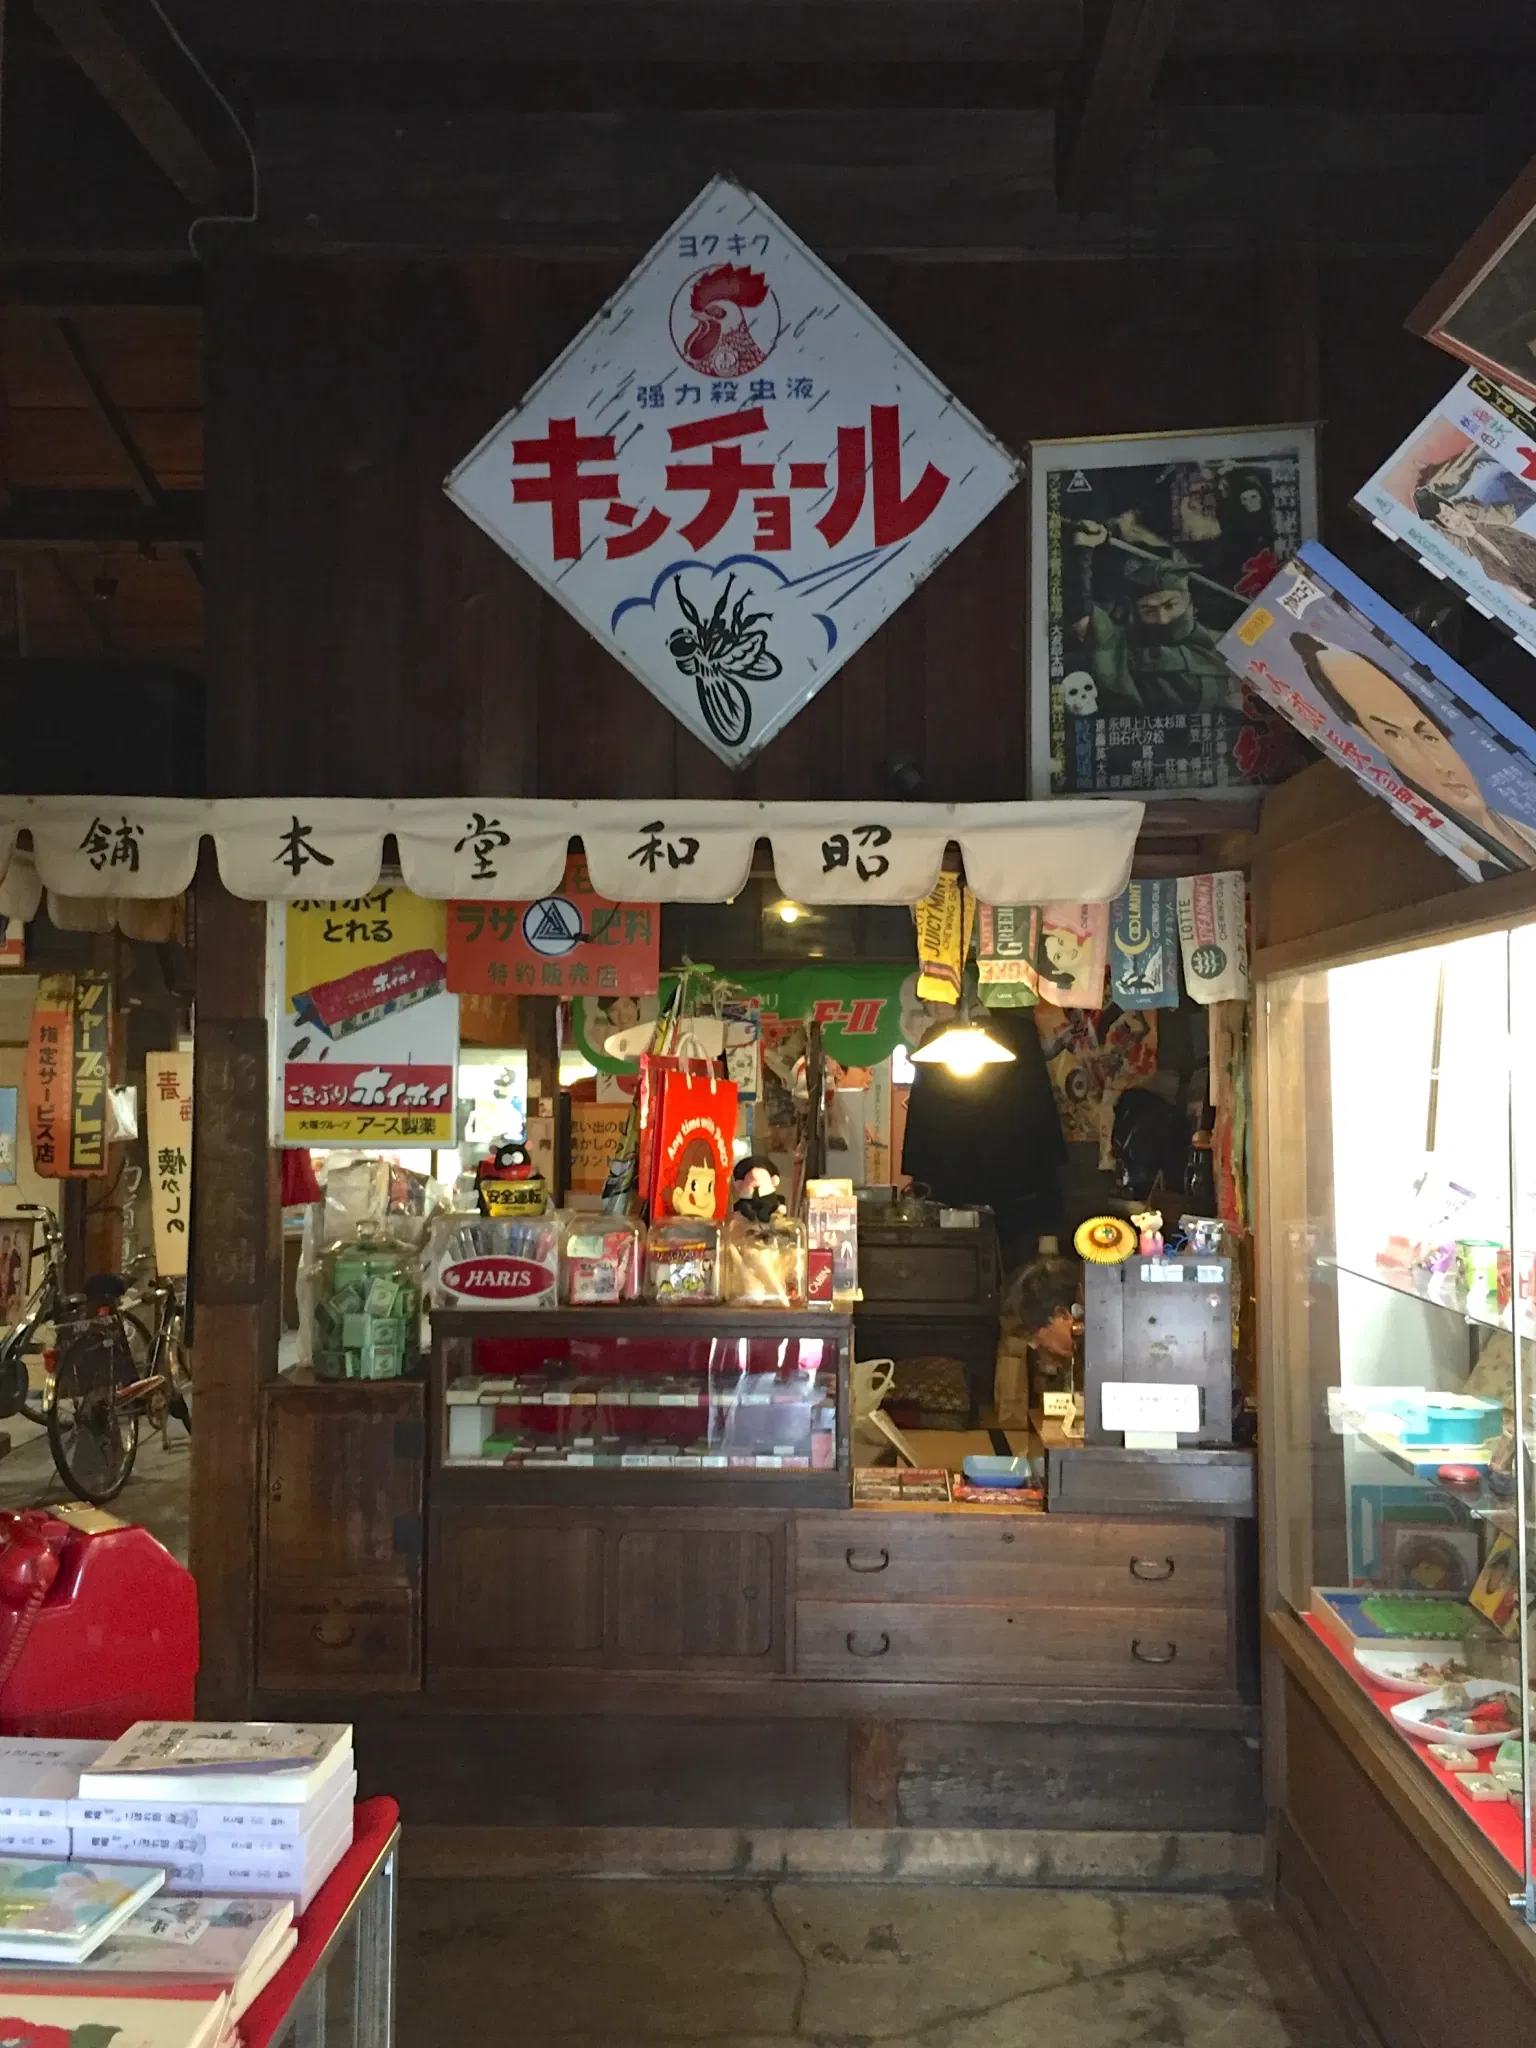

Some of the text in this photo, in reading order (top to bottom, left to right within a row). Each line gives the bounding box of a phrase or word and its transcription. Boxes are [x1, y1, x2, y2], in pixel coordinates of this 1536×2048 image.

[678, 232, 770, 258] ヨクキク
[511, 403, 951, 561] キンチョール
[322, 918, 393, 943] とれる
[455, 904, 654, 947] ラサ 肥料
[1178, 898, 1194, 941] LOTTE
[487, 960, 620, 990] 特約販売店
[35, 1025, 59, 1165] 指定サービス店
[287, 1065, 450, 1108] ごきぶりホイホイ
[356, 1116, 437, 1136] アース製薬
[667, 1131, 684, 1161] Any
[681, 1117, 701, 1136] time
[487, 1189, 542, 1205] 安全運転
[464, 1269, 532, 1289] HARIS
[808, 1265, 832, 1294] CABIN
